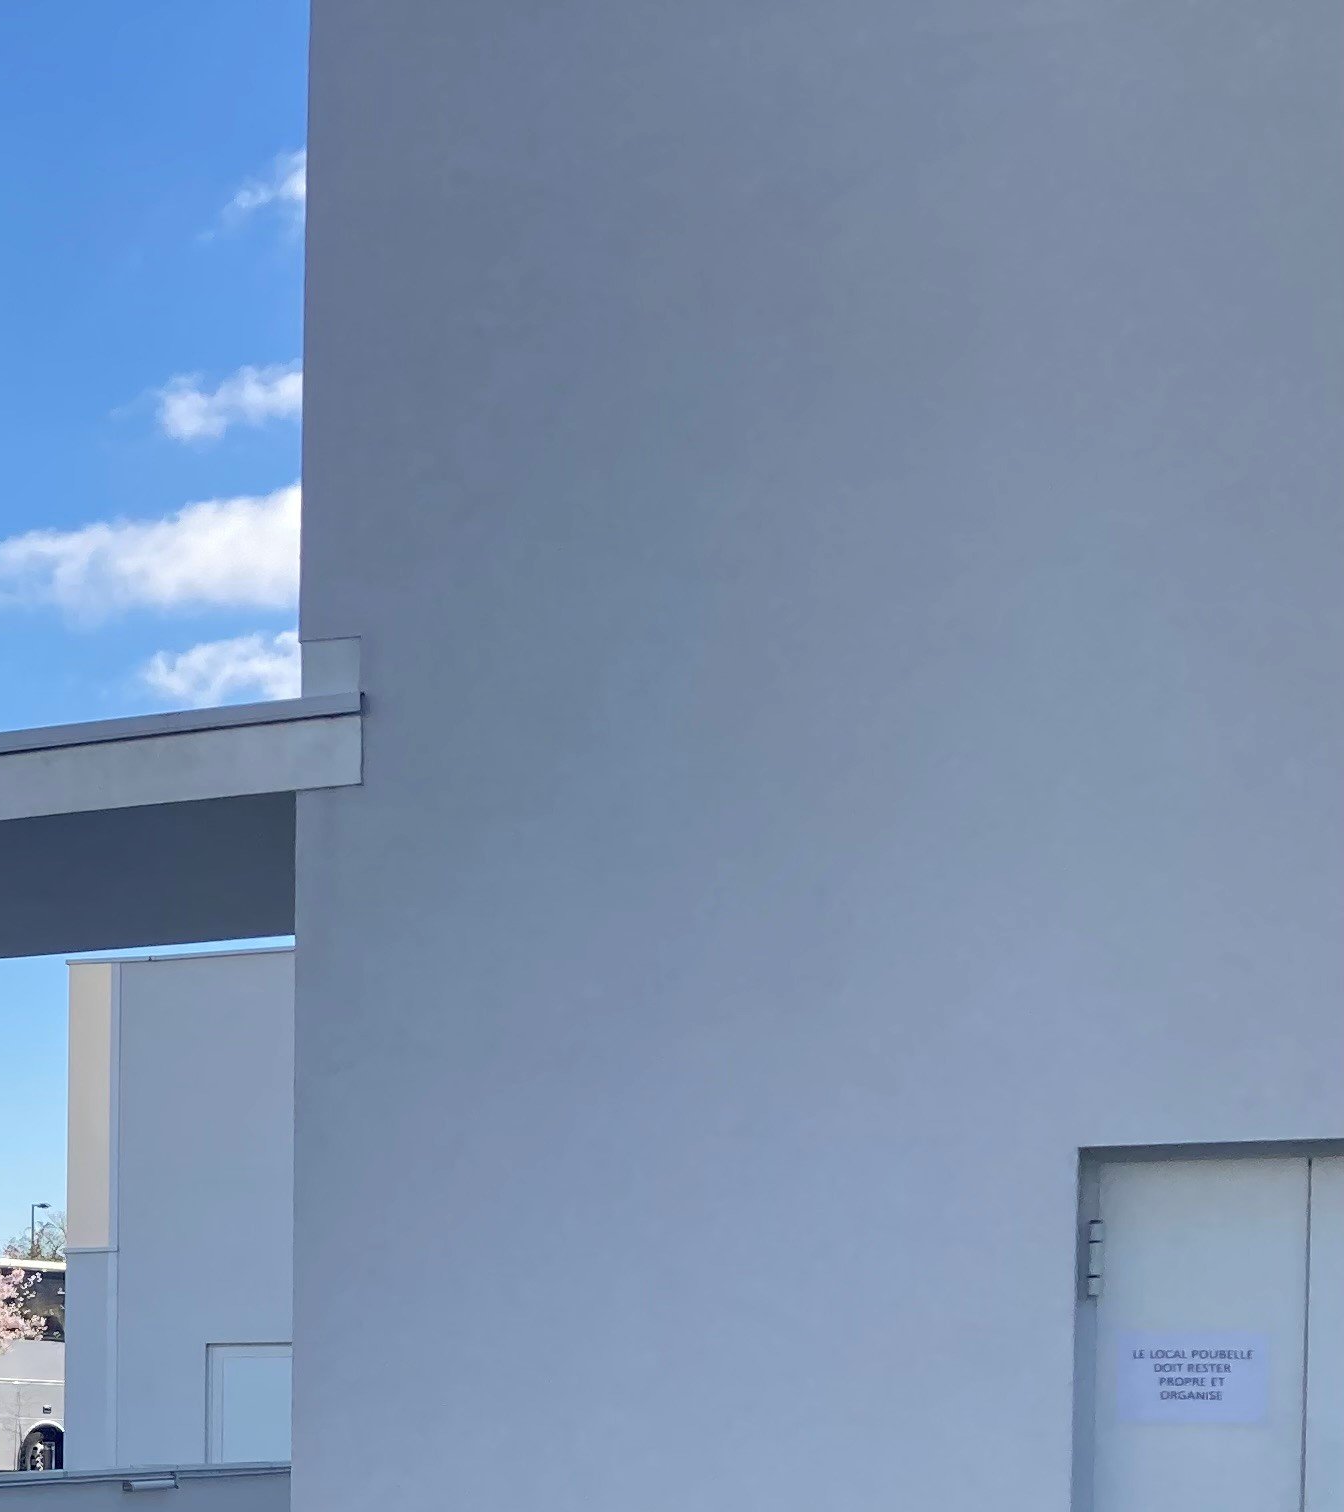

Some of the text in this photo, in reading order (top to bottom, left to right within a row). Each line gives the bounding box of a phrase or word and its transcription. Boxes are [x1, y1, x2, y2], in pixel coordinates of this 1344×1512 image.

[1132, 1349, 1254, 1360] LE LOCAL POUBELLE
[1154, 1363, 1231, 1373] DOIT RESTER
[1159, 1377, 1226, 1387] PROPRE ET
[1159, 1391, 1223, 1401] ORGANISE
